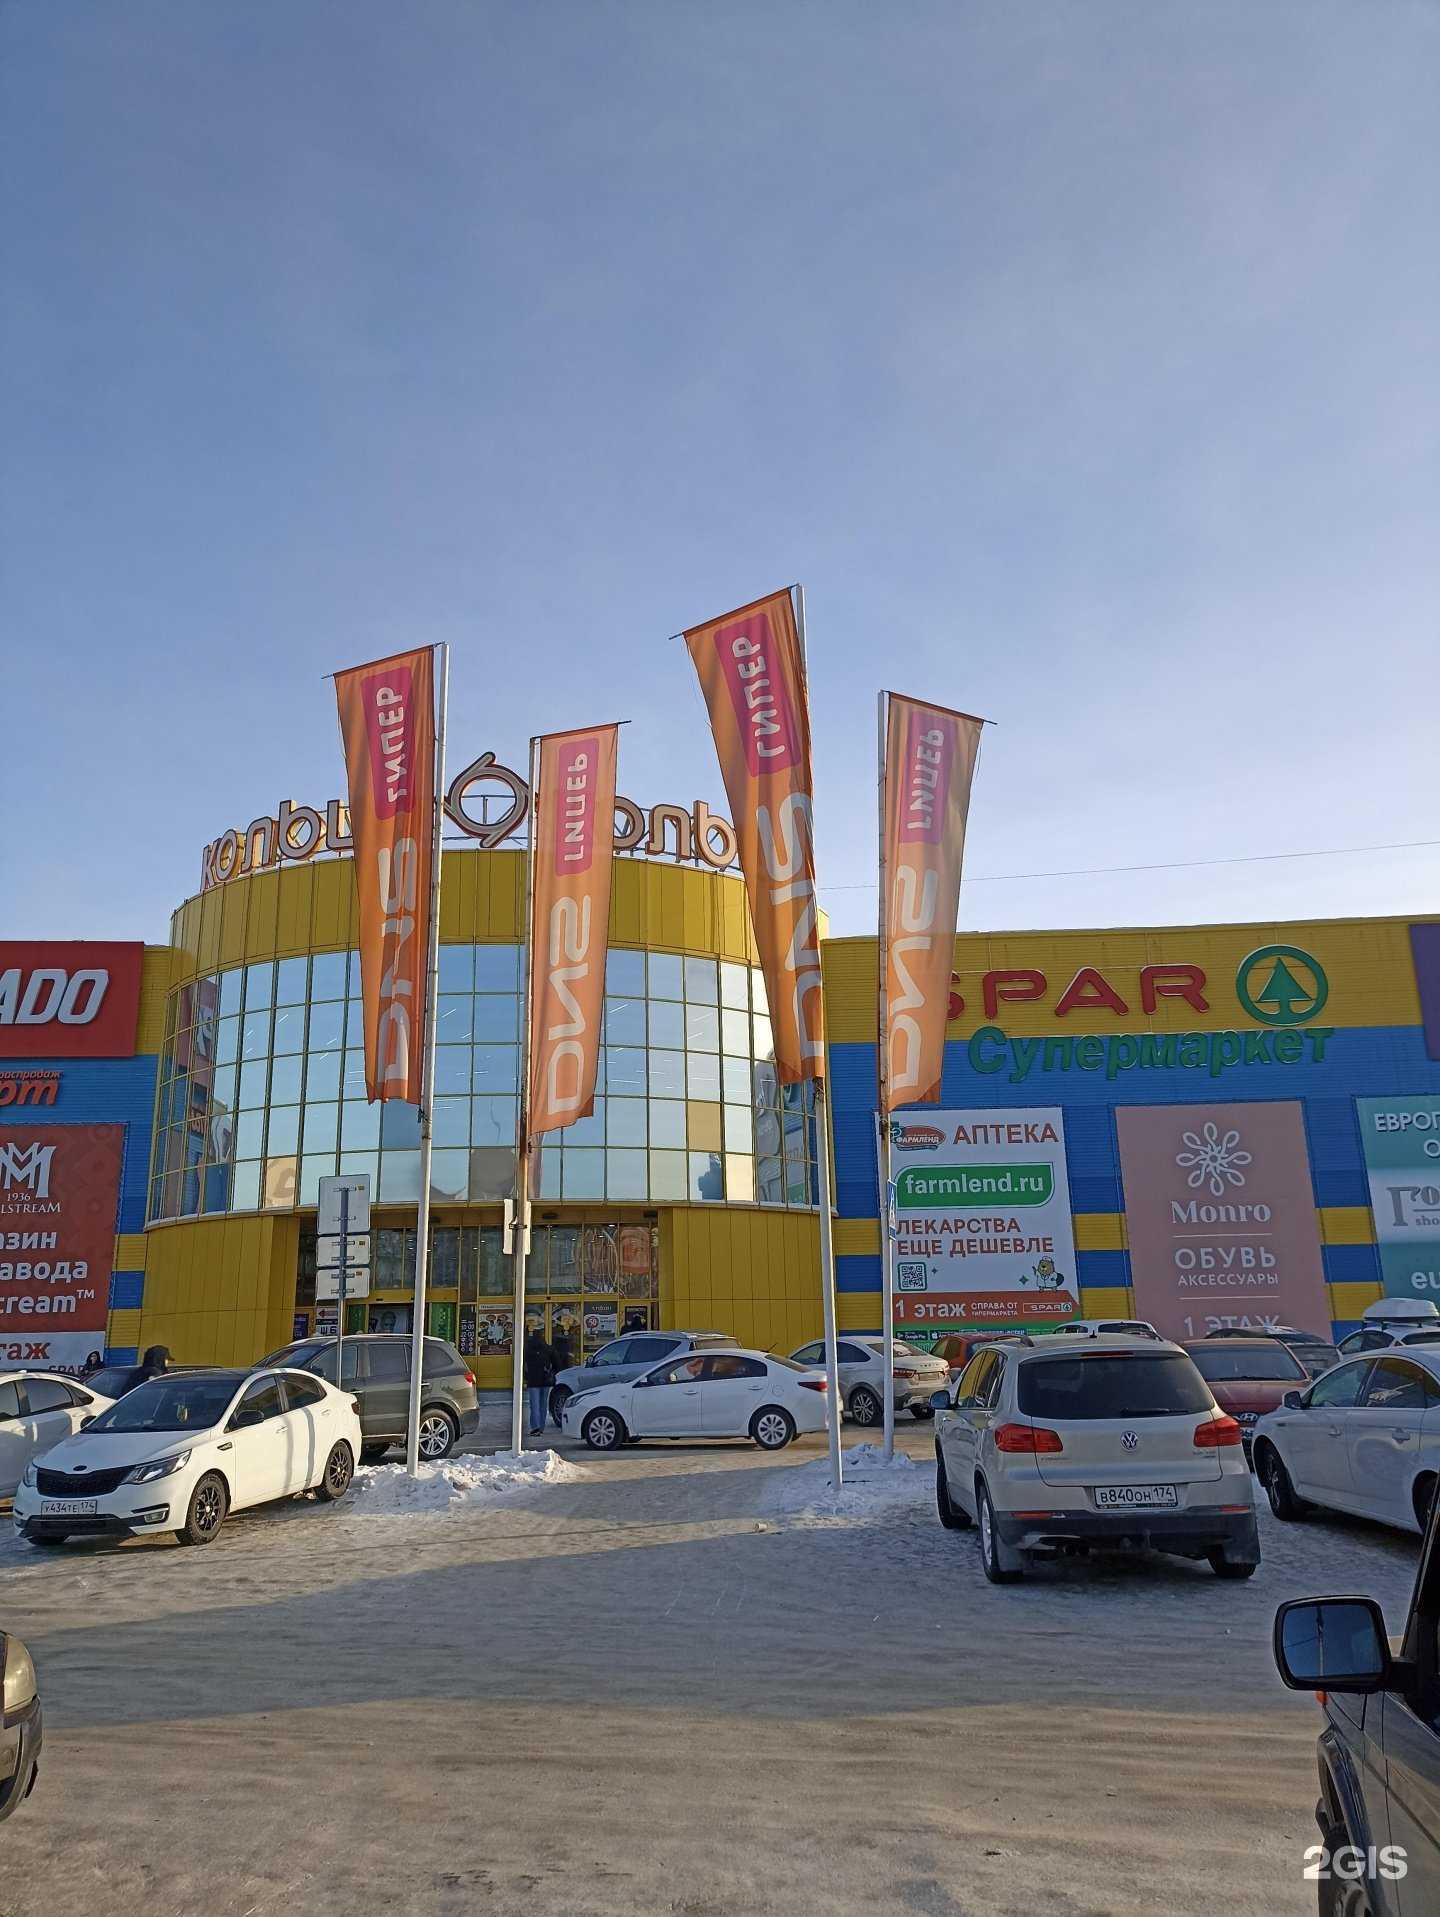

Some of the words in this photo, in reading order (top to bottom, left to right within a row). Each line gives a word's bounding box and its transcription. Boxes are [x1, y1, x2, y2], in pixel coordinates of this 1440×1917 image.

[732, 635, 786, 759] ГИПЕР
[376, 686, 406, 804] ГИПЕР
[968, 1025, 1335, 1083] Супермаркет
[953, 1123, 1060, 1145] АПТЕКА
[905, 1172, 1044, 1194] farmlend.ru
[8, 1192, 31, 1201] 1936
[1171, 1200, 1272, 1224] Monro
[896, 1218, 1022, 1235] ЛЕКАРСТВА
[897, 1239, 943, 1258] ЕЩЕ
[949, 1237, 1054, 1258] ДЕШЕВЛЕ
[1174, 1246, 1277, 1270] ОБУВЬ
[1177, 1273, 1279, 1287] АКСЕССУАРЫ
[895, 1299, 905, 1317] 1
[914, 1301, 967, 1317] этаж
[971, 1302, 1006, 1311] СПРАВА
[1007, 1302, 1018, 1310] ОТ
[1184, 1316, 1194, 1337] 1
[1100, 1488, 1152, 1503] В840ОН
[1153, 1487, 1173, 1498] 174
